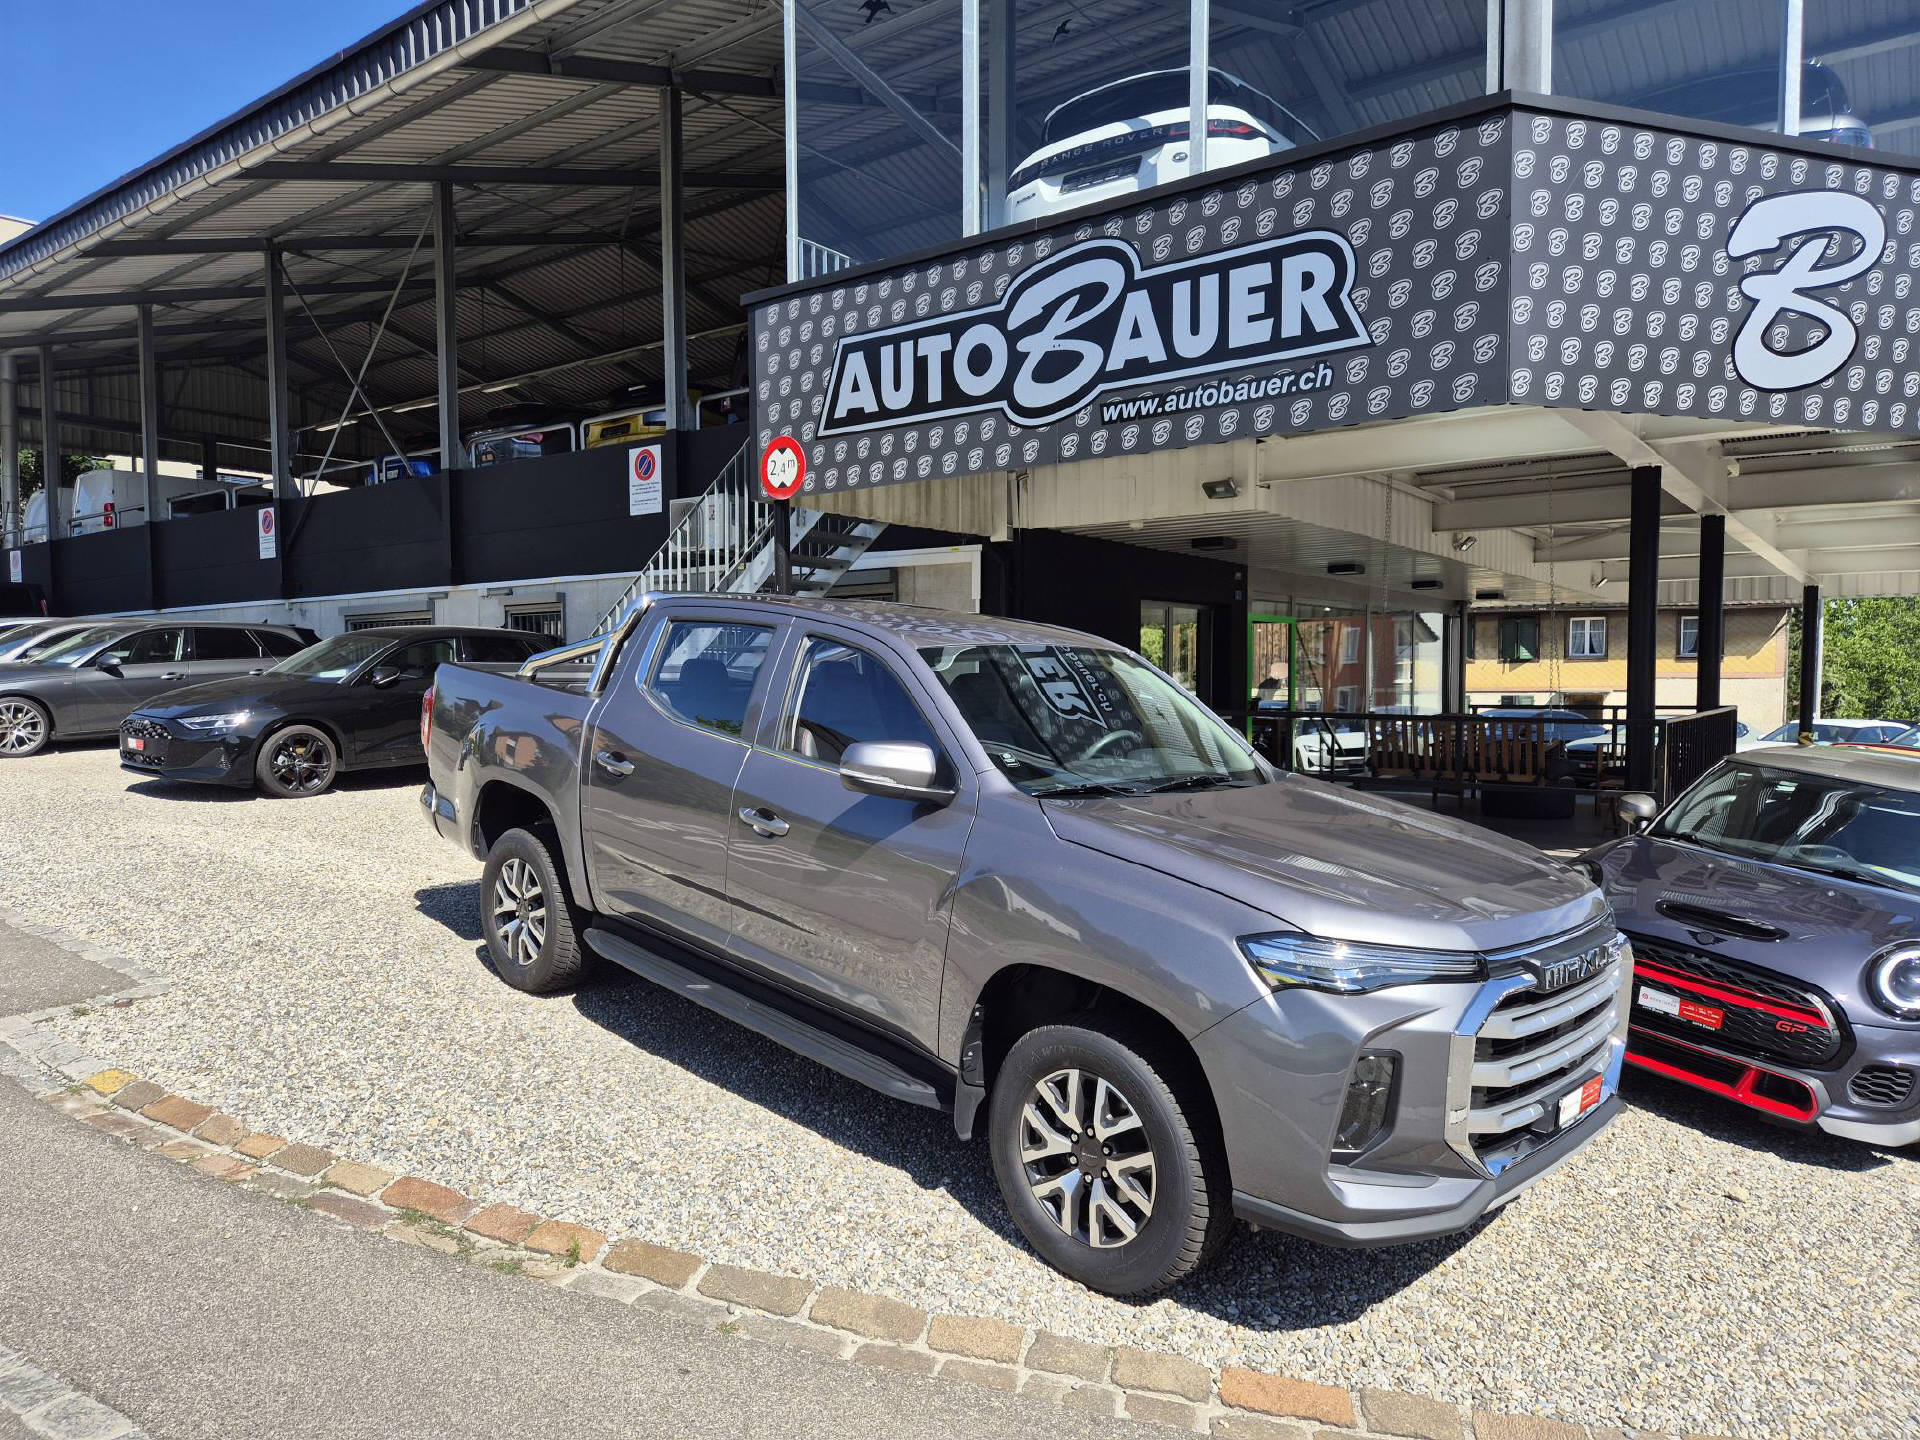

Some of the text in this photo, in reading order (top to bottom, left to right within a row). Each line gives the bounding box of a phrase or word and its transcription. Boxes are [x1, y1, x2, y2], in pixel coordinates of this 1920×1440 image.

[1040, 127, 1163, 170] RANGE ROVER
[1728, 191, 1885, 389] B
[833, 251, 1340, 419] AUTO BAUER
[1102, 363, 1333, 422] www.autobauer.ch
[1775, 1020, 1808, 1033] GP
